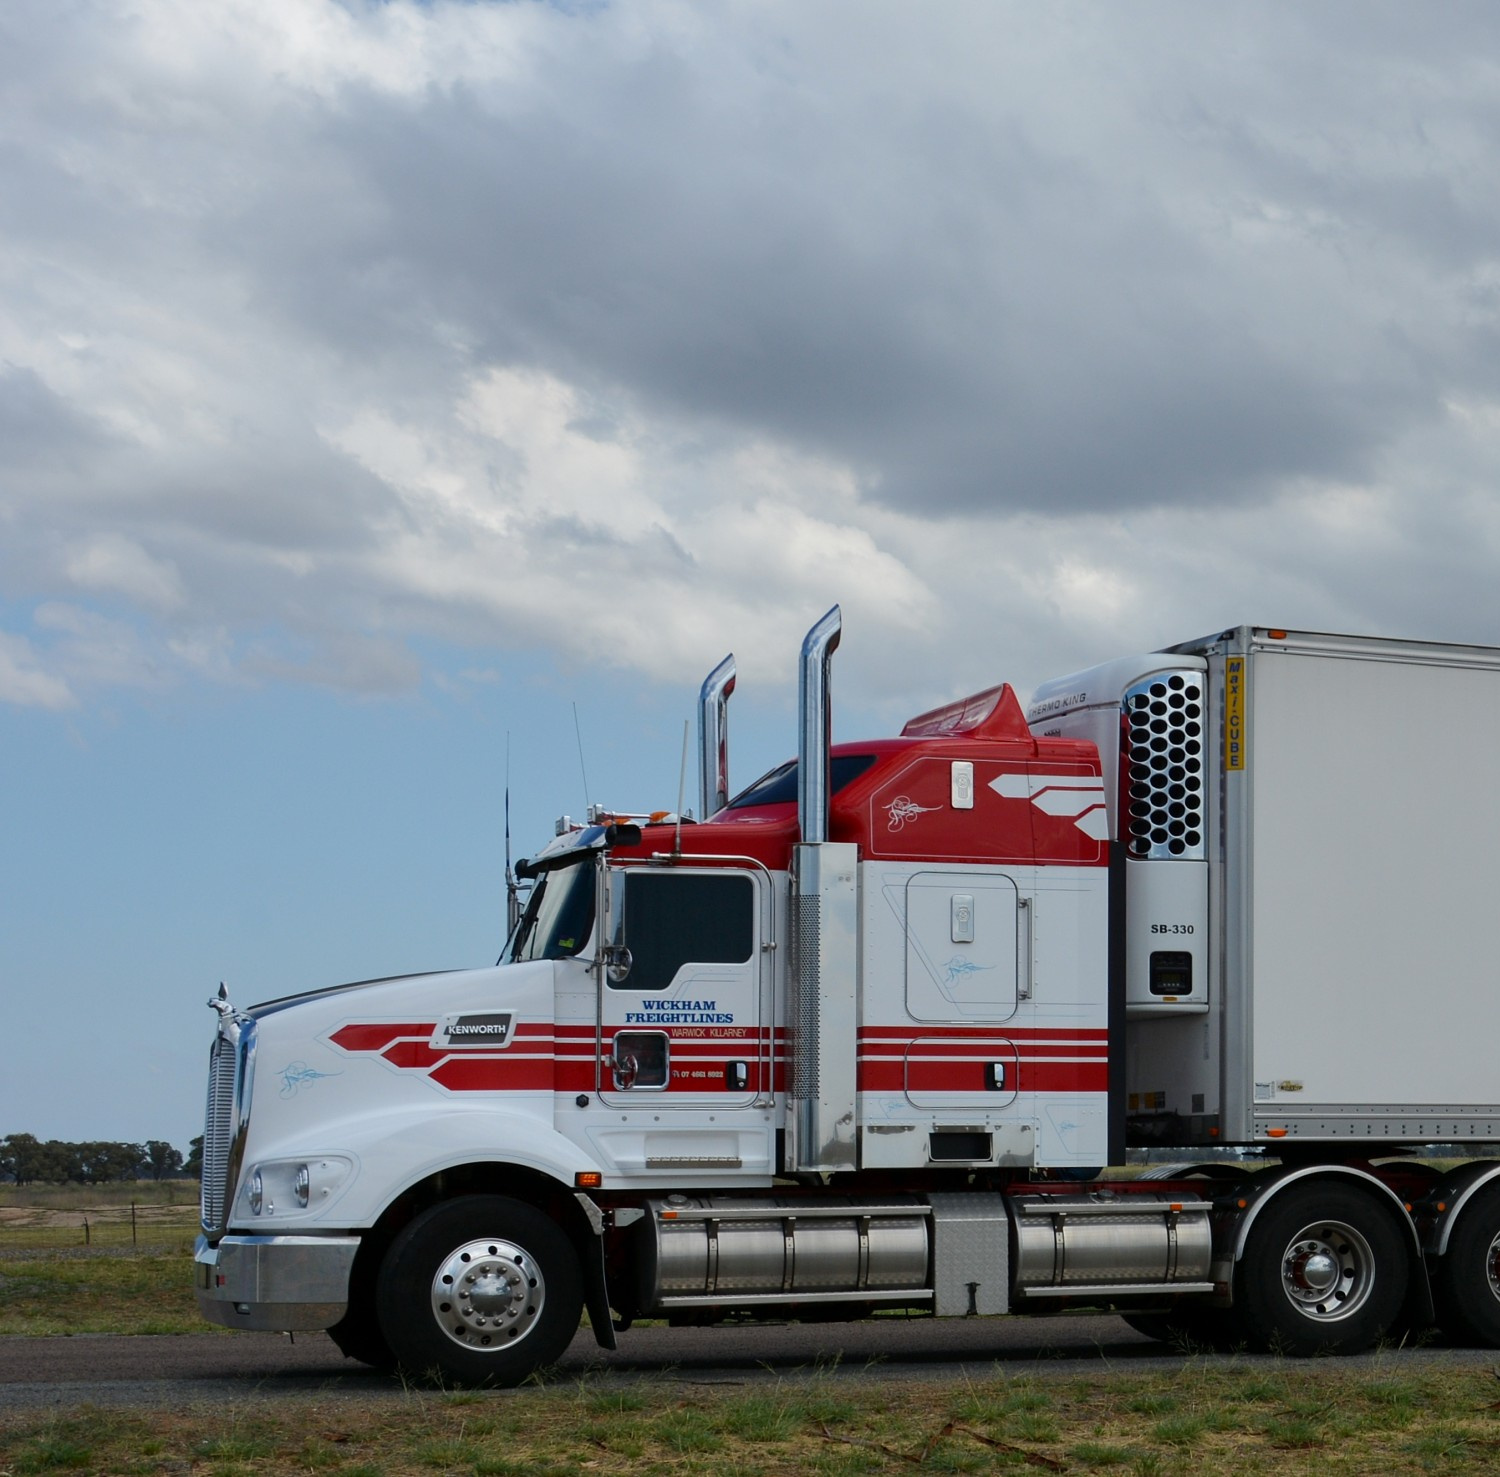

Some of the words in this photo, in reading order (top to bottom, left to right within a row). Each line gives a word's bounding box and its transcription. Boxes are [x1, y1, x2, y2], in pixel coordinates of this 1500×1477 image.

[1028, 700, 1061, 718] THERMO
[1062, 692, 1087, 707] KING
[1229, 662, 1241, 767] Maxi-CUBE
[1151, 924, 1195, 935] SB-330
[642, 1000, 716, 1011] WICKHAM
[626, 1013, 734, 1024] FREIGHTLINES
[448, 1024, 507, 1035] KENWORTH
[671, 1028, 706, 1038] WARWICK
[709, 1028, 747, 1038] KILLARNEY
[681, 1070, 690, 1078] 07
